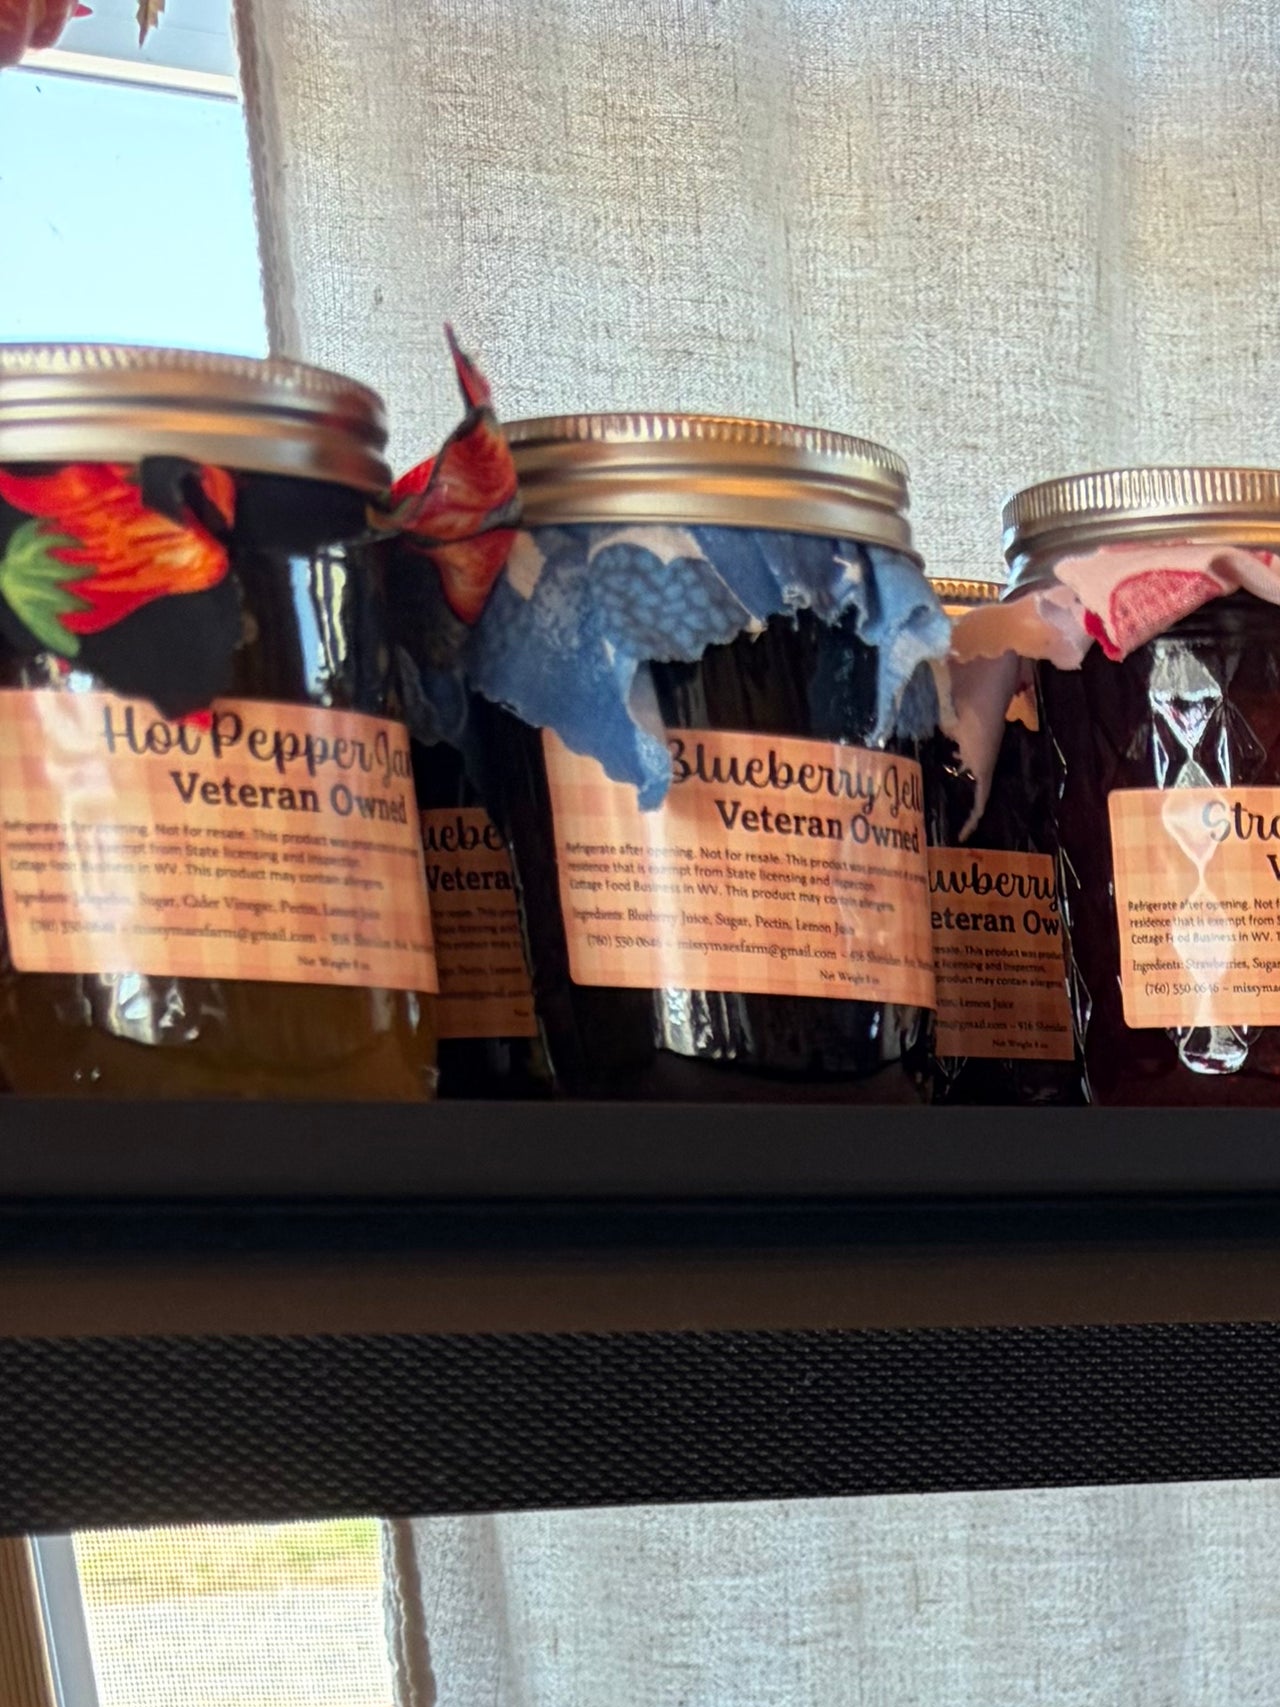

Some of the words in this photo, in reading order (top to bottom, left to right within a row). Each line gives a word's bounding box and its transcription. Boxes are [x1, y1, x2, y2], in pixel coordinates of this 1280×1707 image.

[209, 709, 373, 778] Pepper
[169, 770, 321, 813] Veteran
[328, 783, 409, 826] Owned
[668, 738, 880, 818] Blueberry
[880, 762, 926, 817] Jell
[714, 799, 844, 841] Veteran
[849, 813, 921, 855] Owned
